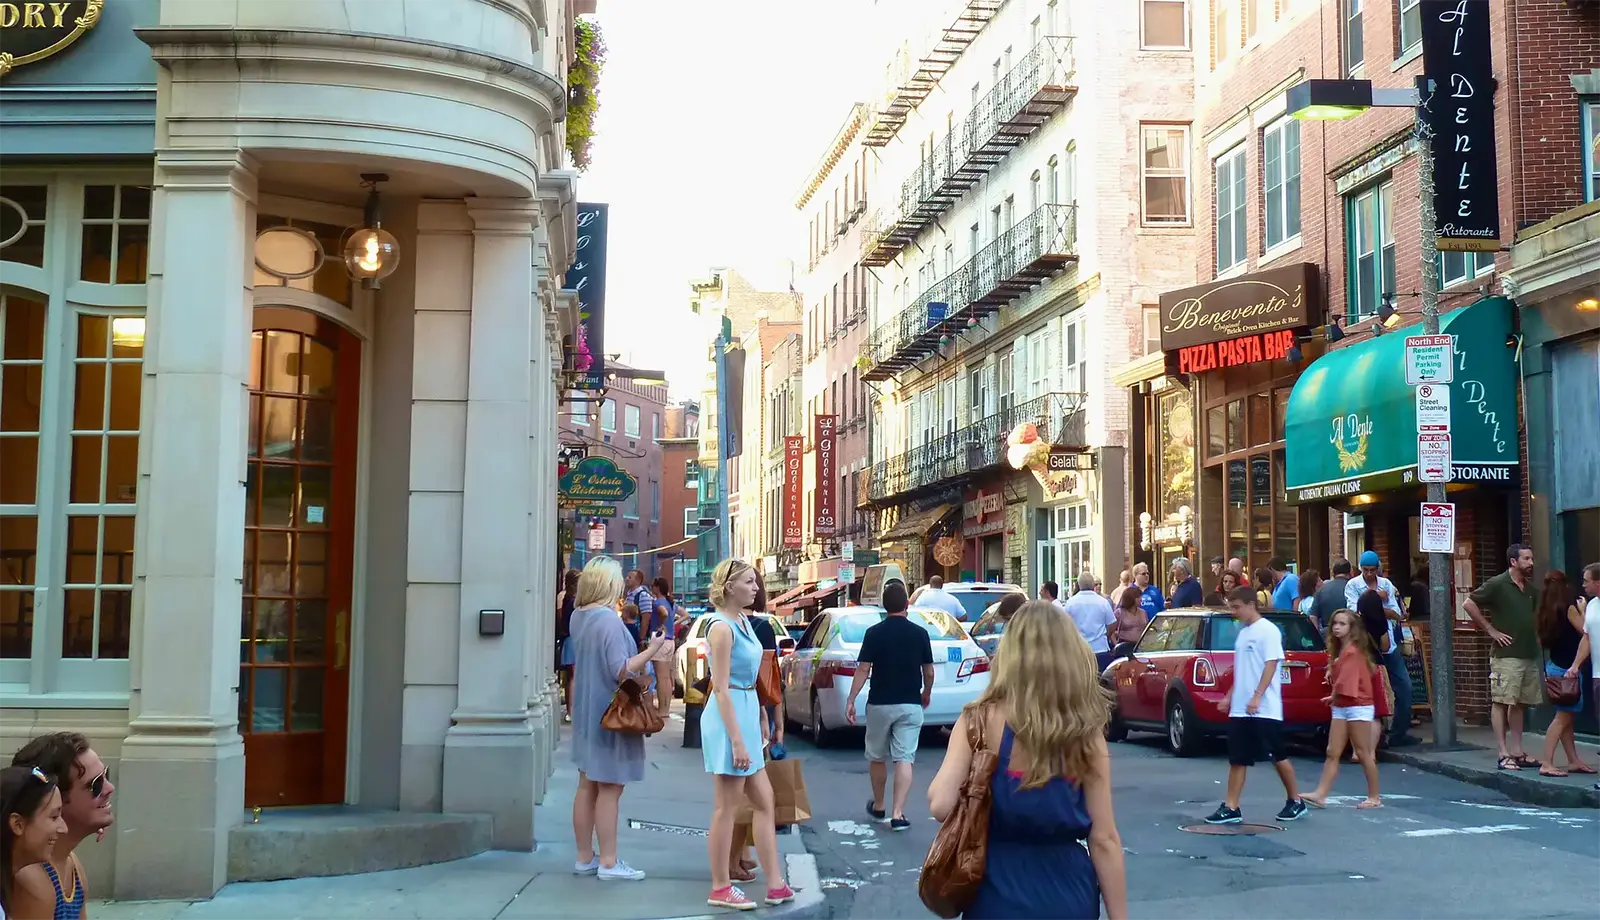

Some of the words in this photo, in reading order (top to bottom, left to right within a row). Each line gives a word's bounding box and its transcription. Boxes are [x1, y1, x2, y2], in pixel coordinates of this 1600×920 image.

[0, 3, 71, 28] DRY
[1435, 223, 1494, 236] Ristorante
[1163, 281, 1301, 333] Benevento's
[1408, 338, 1432, 346] North
[1434, 336, 1450, 345] End
[1179, 342, 1216, 374] PIZZA
[1218, 335, 1262, 367] PASTA
[1264, 329, 1295, 360] BAR
[1415, 361, 1442, 369] Parking
[1421, 368, 1436, 376] Only
[1330, 416, 1344, 443] Al
[1347, 413, 1374, 438] Dente
[1403, 470, 1413, 484] 109
[1299, 487, 1324, 501] AUTHENTIC
[1323, 483, 1341, 497] ITALIAN
[1342, 480, 1360, 495] CUISINE
